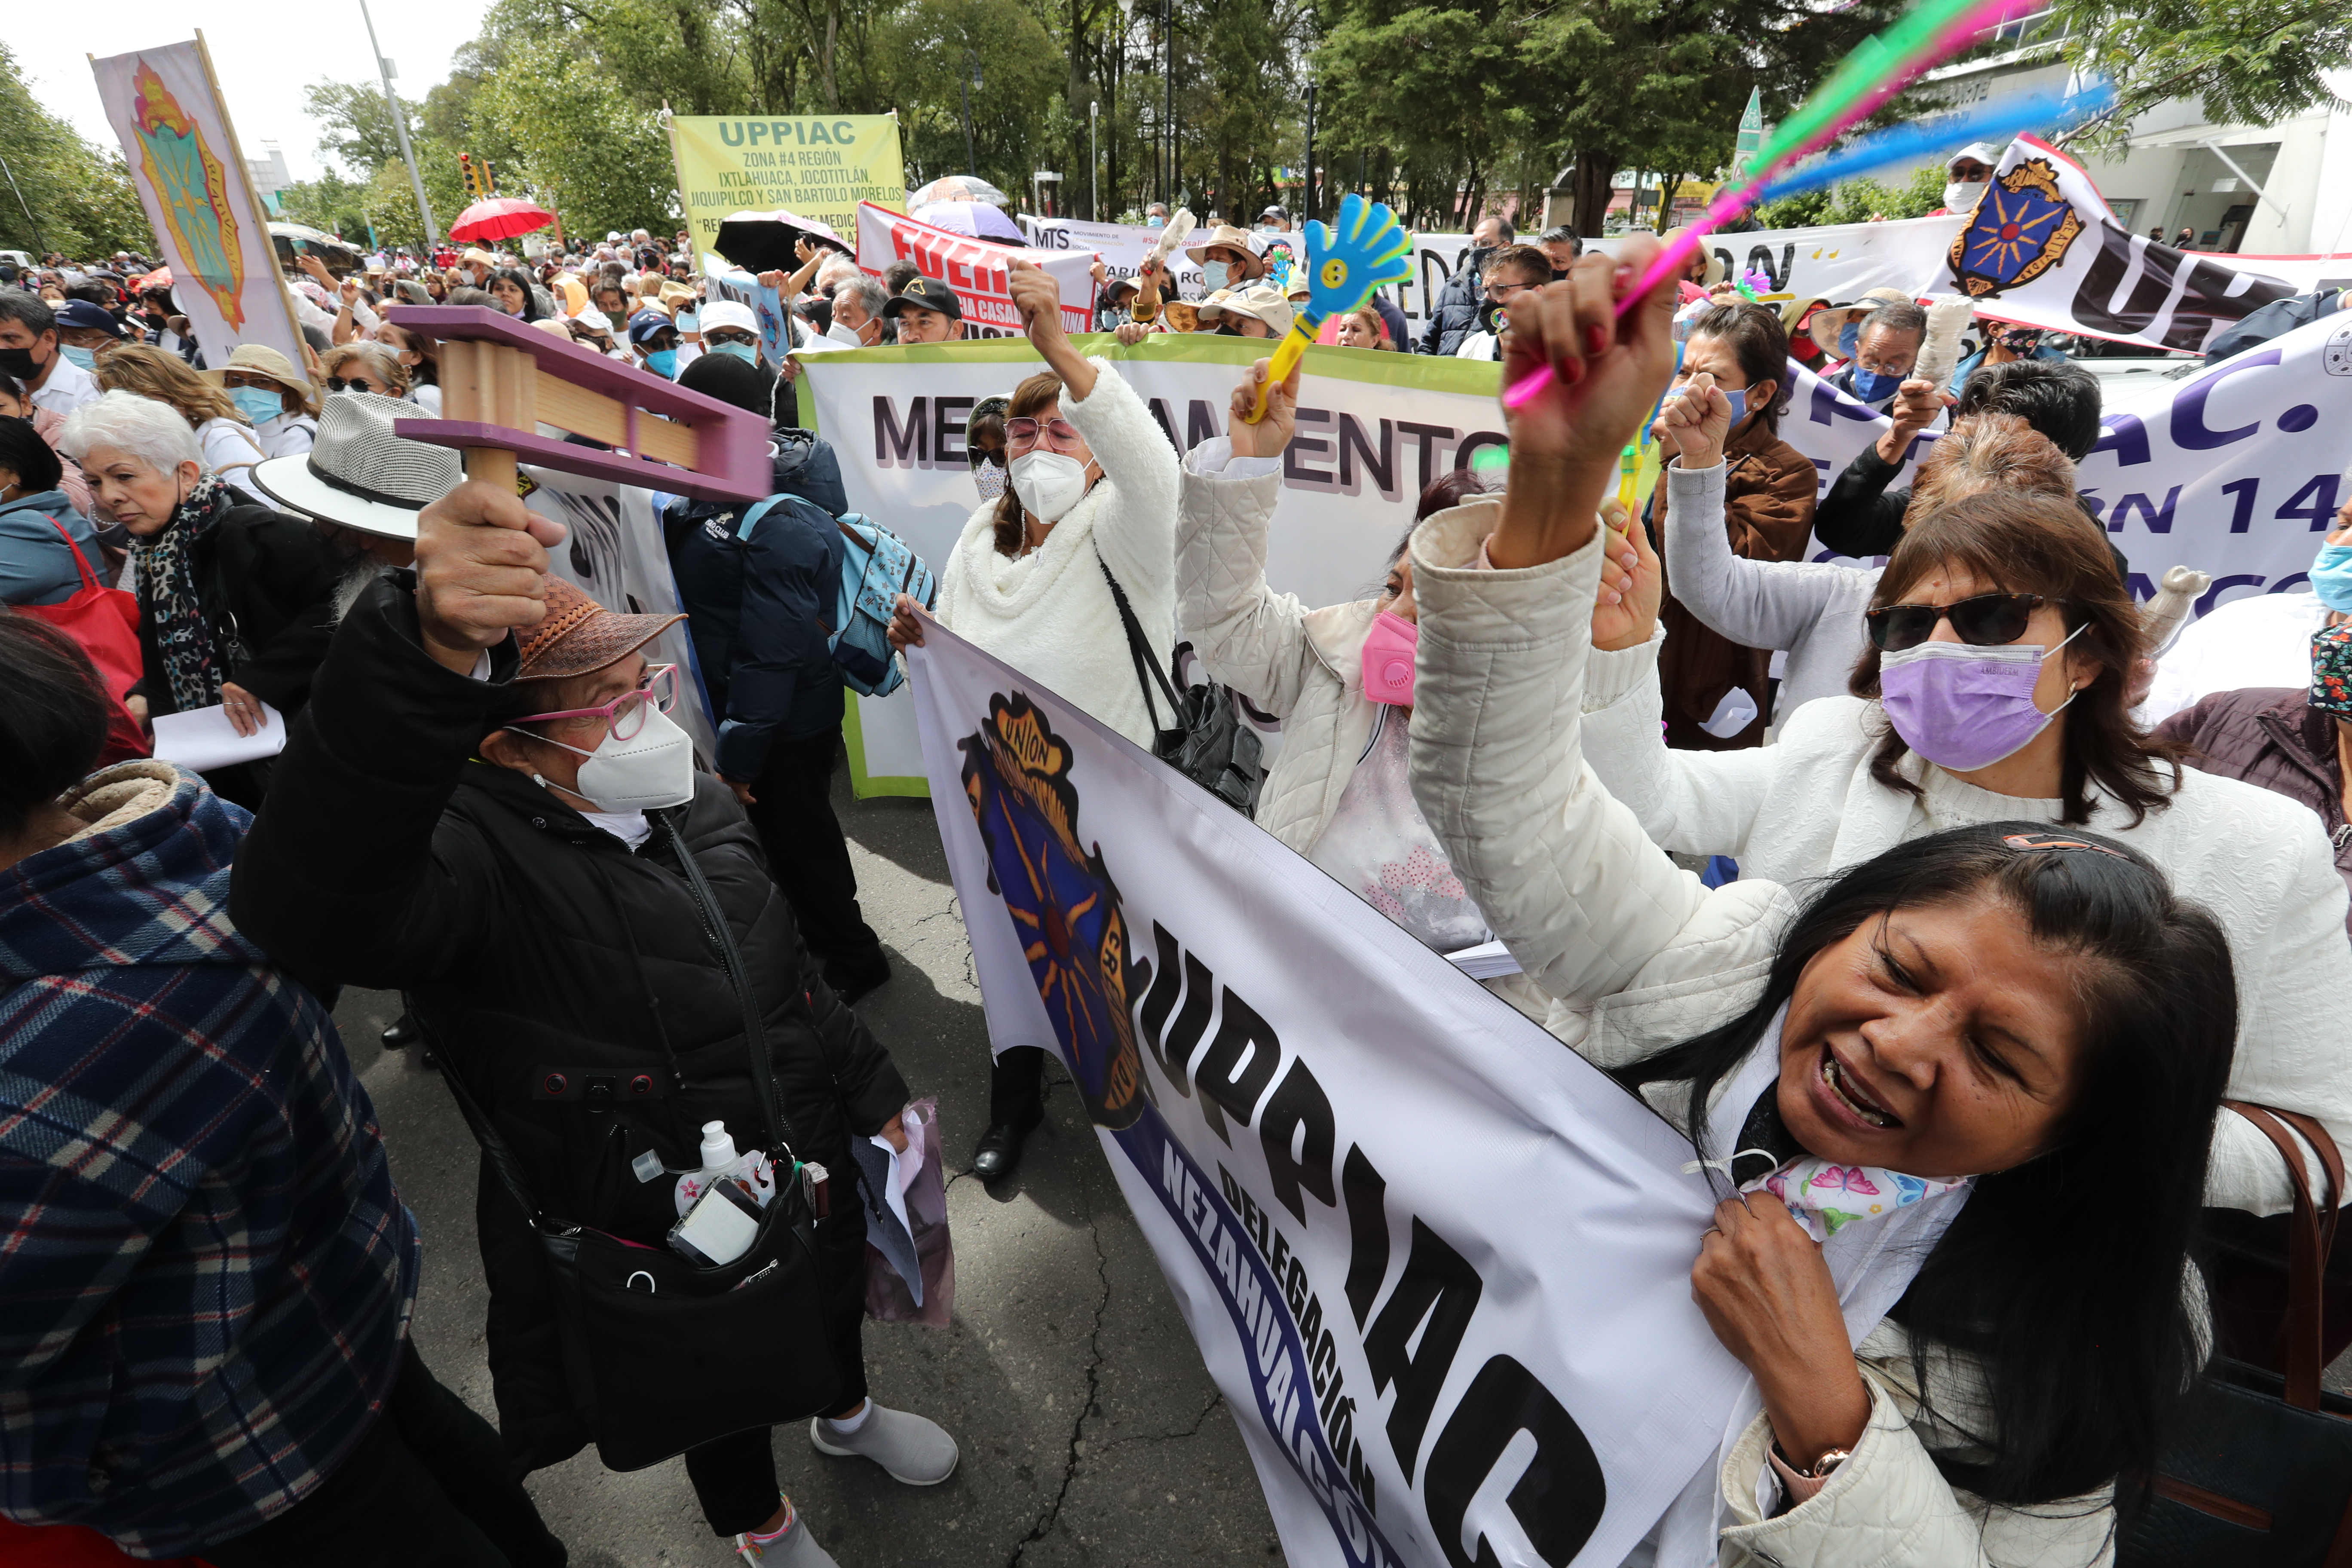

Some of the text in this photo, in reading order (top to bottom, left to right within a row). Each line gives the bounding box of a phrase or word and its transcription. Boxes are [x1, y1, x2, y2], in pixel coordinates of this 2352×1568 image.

[719, 121, 856, 147] UPPIAC
[743, 148, 841, 168] ZONA #4 REGIÓN
[719, 165, 873, 187] IXTLAHUACA, JOCOTITLÁN,
[691, 187, 902, 207] JIQUIPILCO Y SAN BARTOLO MORELOS
[1035, 227, 1070, 250] MTS
[1073, 238, 1124, 246] TRANSFORMACIÓN
[1981, 667, 2019, 676] AMBIDERM
[1006, 717, 1050, 767] UNION
[1140, 919, 1607, 1568] UPPIAC
[1216, 1159, 1376, 1520] DELEGACIÓN
[1163, 1138, 1397, 1568] NEZAHUALCÓ
